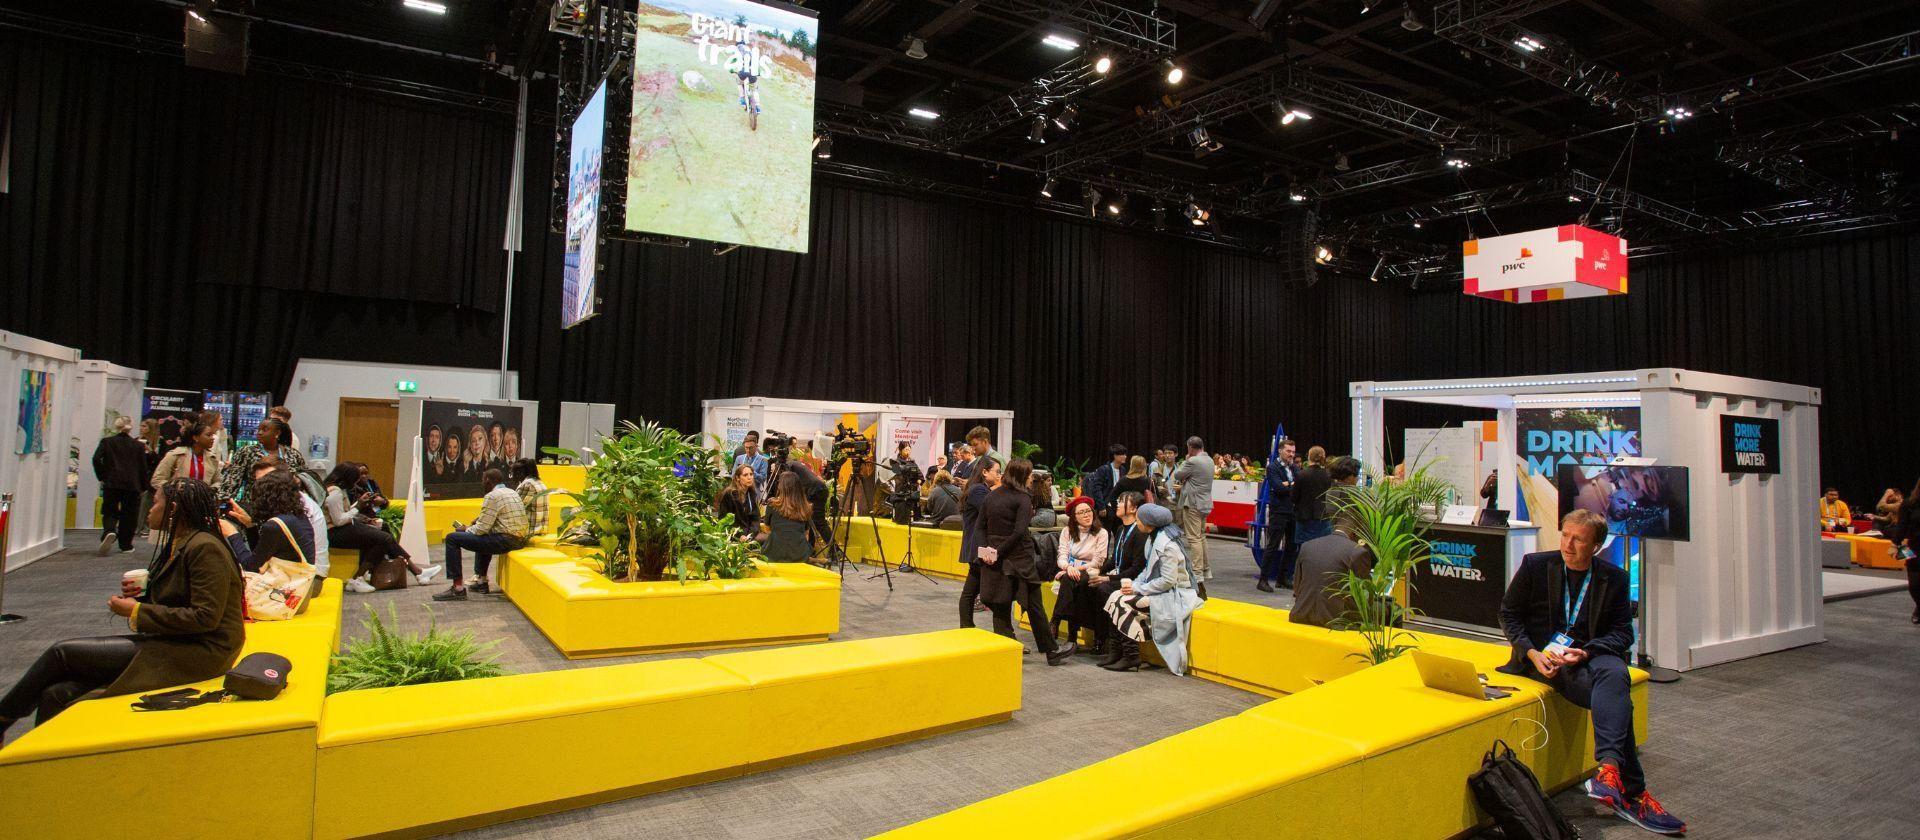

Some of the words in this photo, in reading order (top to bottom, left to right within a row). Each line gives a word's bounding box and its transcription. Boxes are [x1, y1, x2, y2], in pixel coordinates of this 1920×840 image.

[691, 12, 752, 44] Giant
[693, 34, 773, 79] trails
[1502, 262, 1526, 274] pwc
[1594, 260, 1607, 271] pwc
[150, 395, 184, 403] CIRCULARITY
[1734, 422, 1762, 438] DRINK
[1527, 430, 1638, 454] DRINK
[1735, 437, 1760, 452] MORE
[1735, 451, 1766, 466] WATER
[1430, 540, 1477, 556] DRINK
